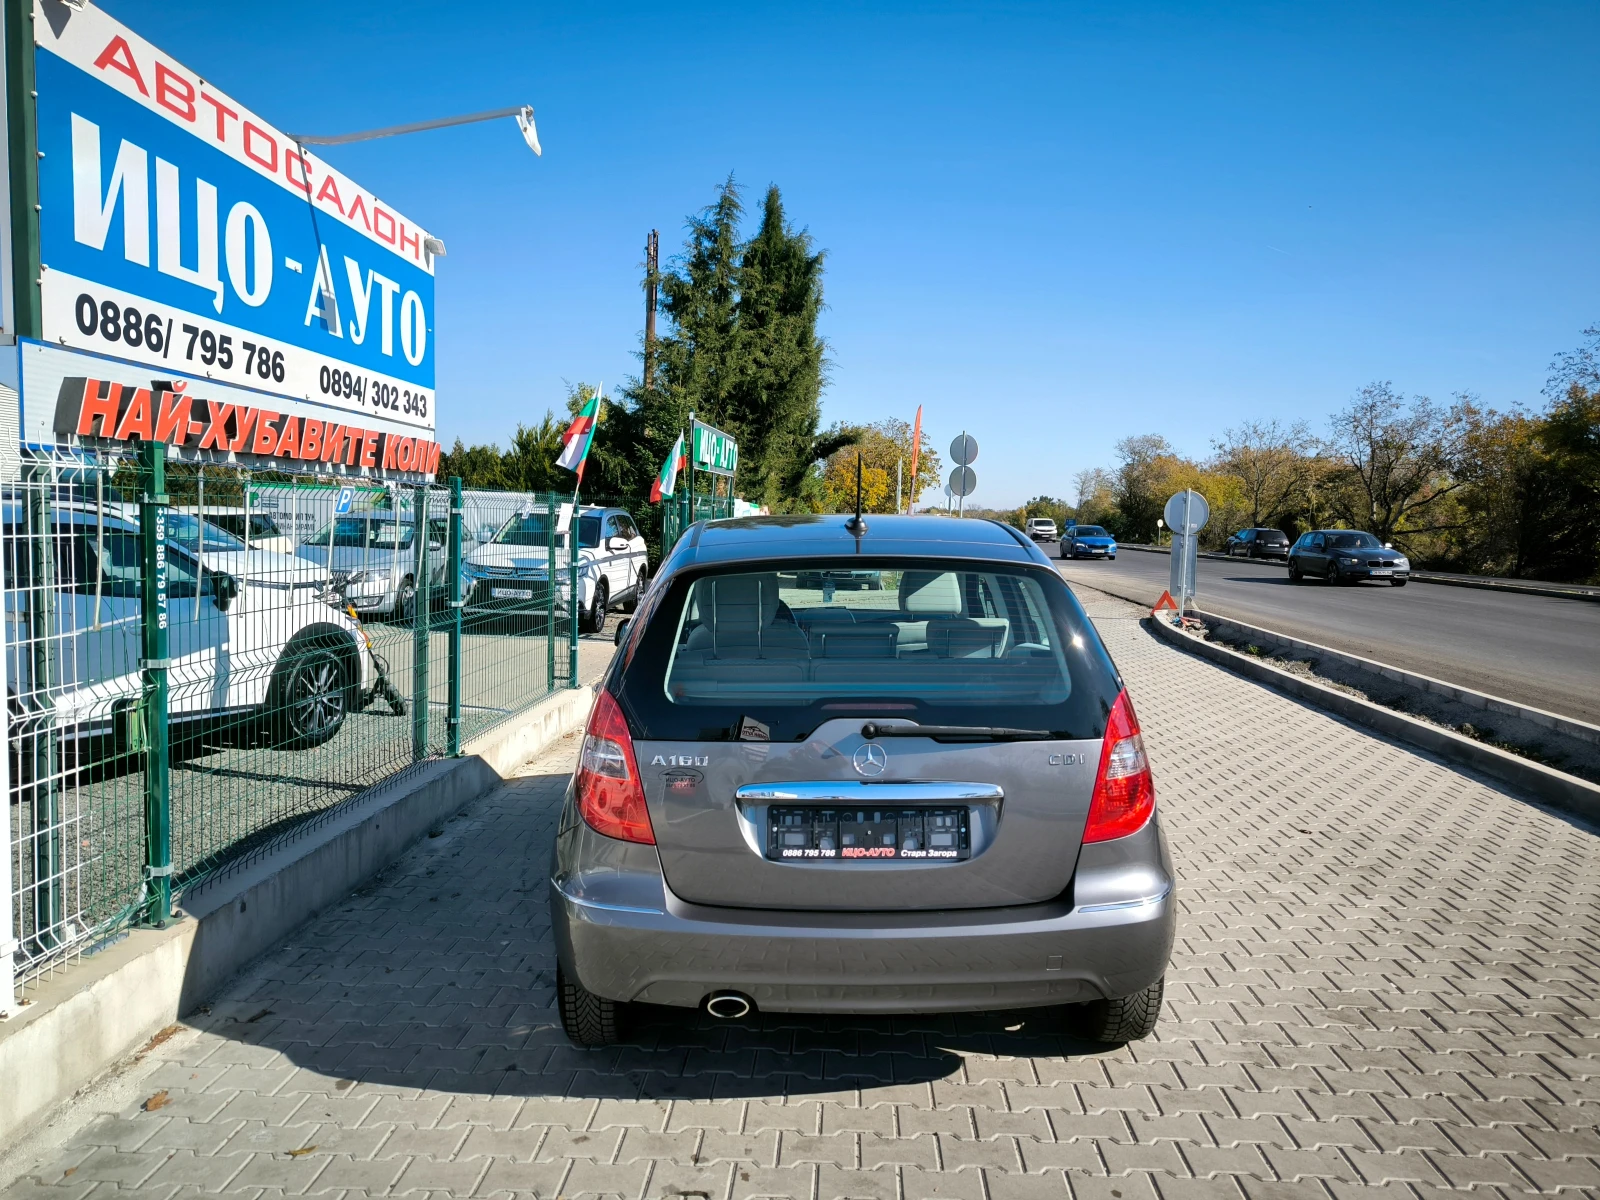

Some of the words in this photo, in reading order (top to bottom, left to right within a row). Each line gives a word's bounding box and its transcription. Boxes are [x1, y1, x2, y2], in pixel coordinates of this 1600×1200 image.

[93, 35, 420, 261] АВТОСАЛОН
[71, 112, 426, 367] ИЦО-АУТО
[75, 293, 173, 359] 0886/
[183, 323, 233, 370] 795
[243, 341, 285, 383] 786
[320, 365, 367, 406] 0894/
[372, 381, 399, 411] 302
[403, 390, 427, 418] 343
[76, 378, 380, 468] НАЙ-ХУБАВИТЕ
[382, 433, 441, 475] КОЛИ
[338, 490, 350, 510] P
[157, 545, 165, 569] 886
[158, 573, 166, 589] 79
[158, 593, 167, 608] 57
[159, 613, 167, 629] 86
[1049, 754, 1085, 765] CDI
[782, 849, 802, 857] 0886
[804, 849, 819, 857] 795
[820, 849, 836, 857] 786
[842, 847, 896, 857] ИЦО-АУТО
[901, 849, 926, 858] Стара
[928, 849, 957, 858] Загора
